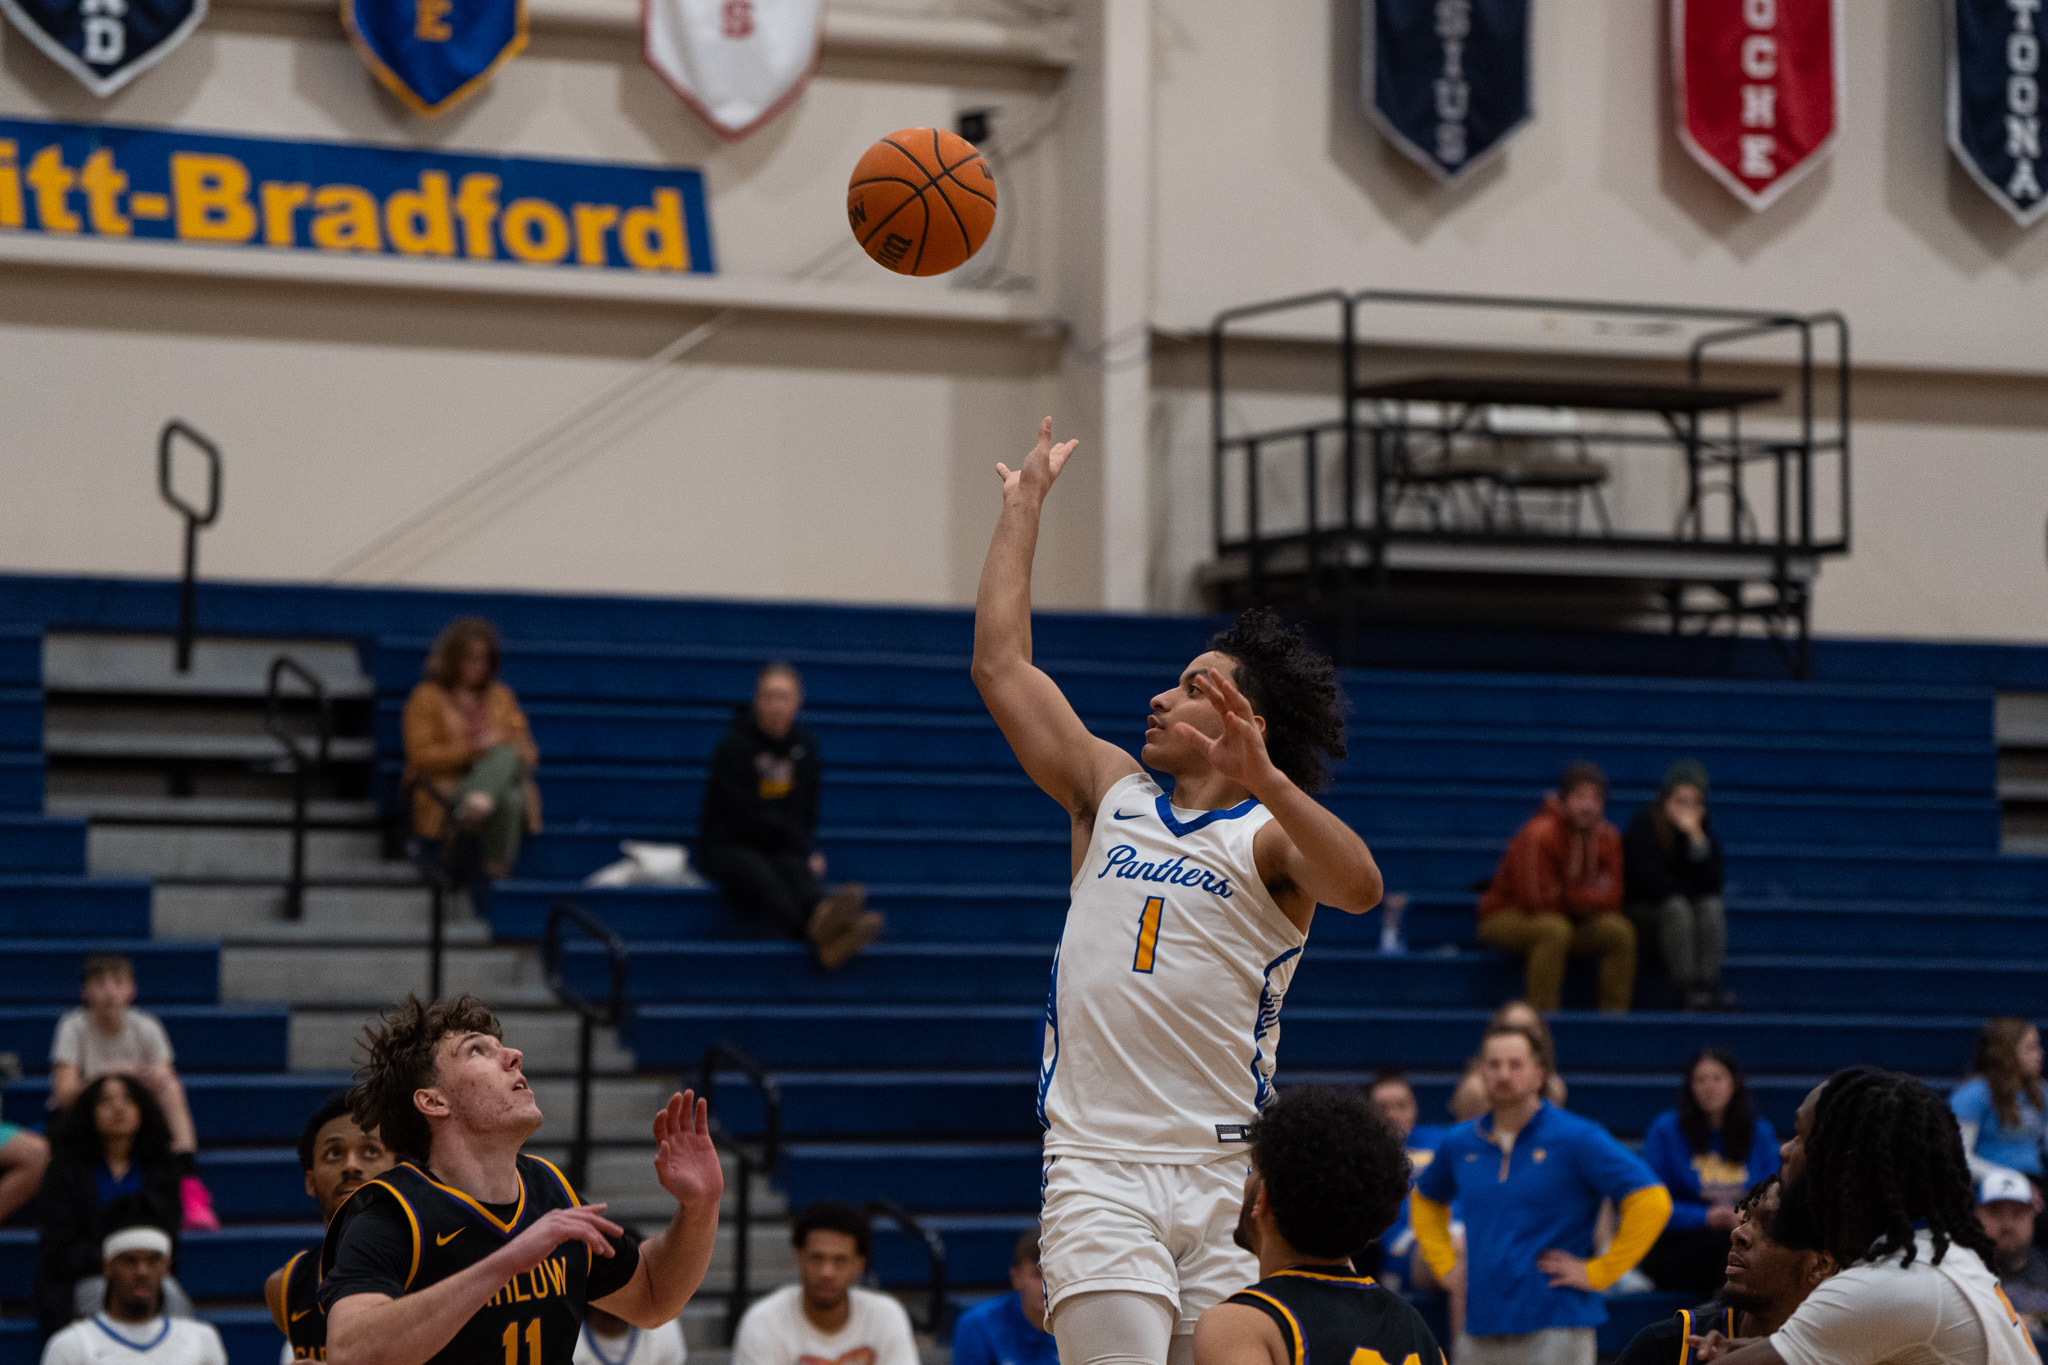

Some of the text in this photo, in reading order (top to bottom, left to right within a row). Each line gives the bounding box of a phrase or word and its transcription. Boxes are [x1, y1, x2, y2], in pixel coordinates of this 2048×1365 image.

[0, 138, 692, 273] itt-Bradford
[1098, 845, 1233, 899] Panthers
[1132, 896, 1165, 974] 1
[502, 1317, 542, 1365] 11
